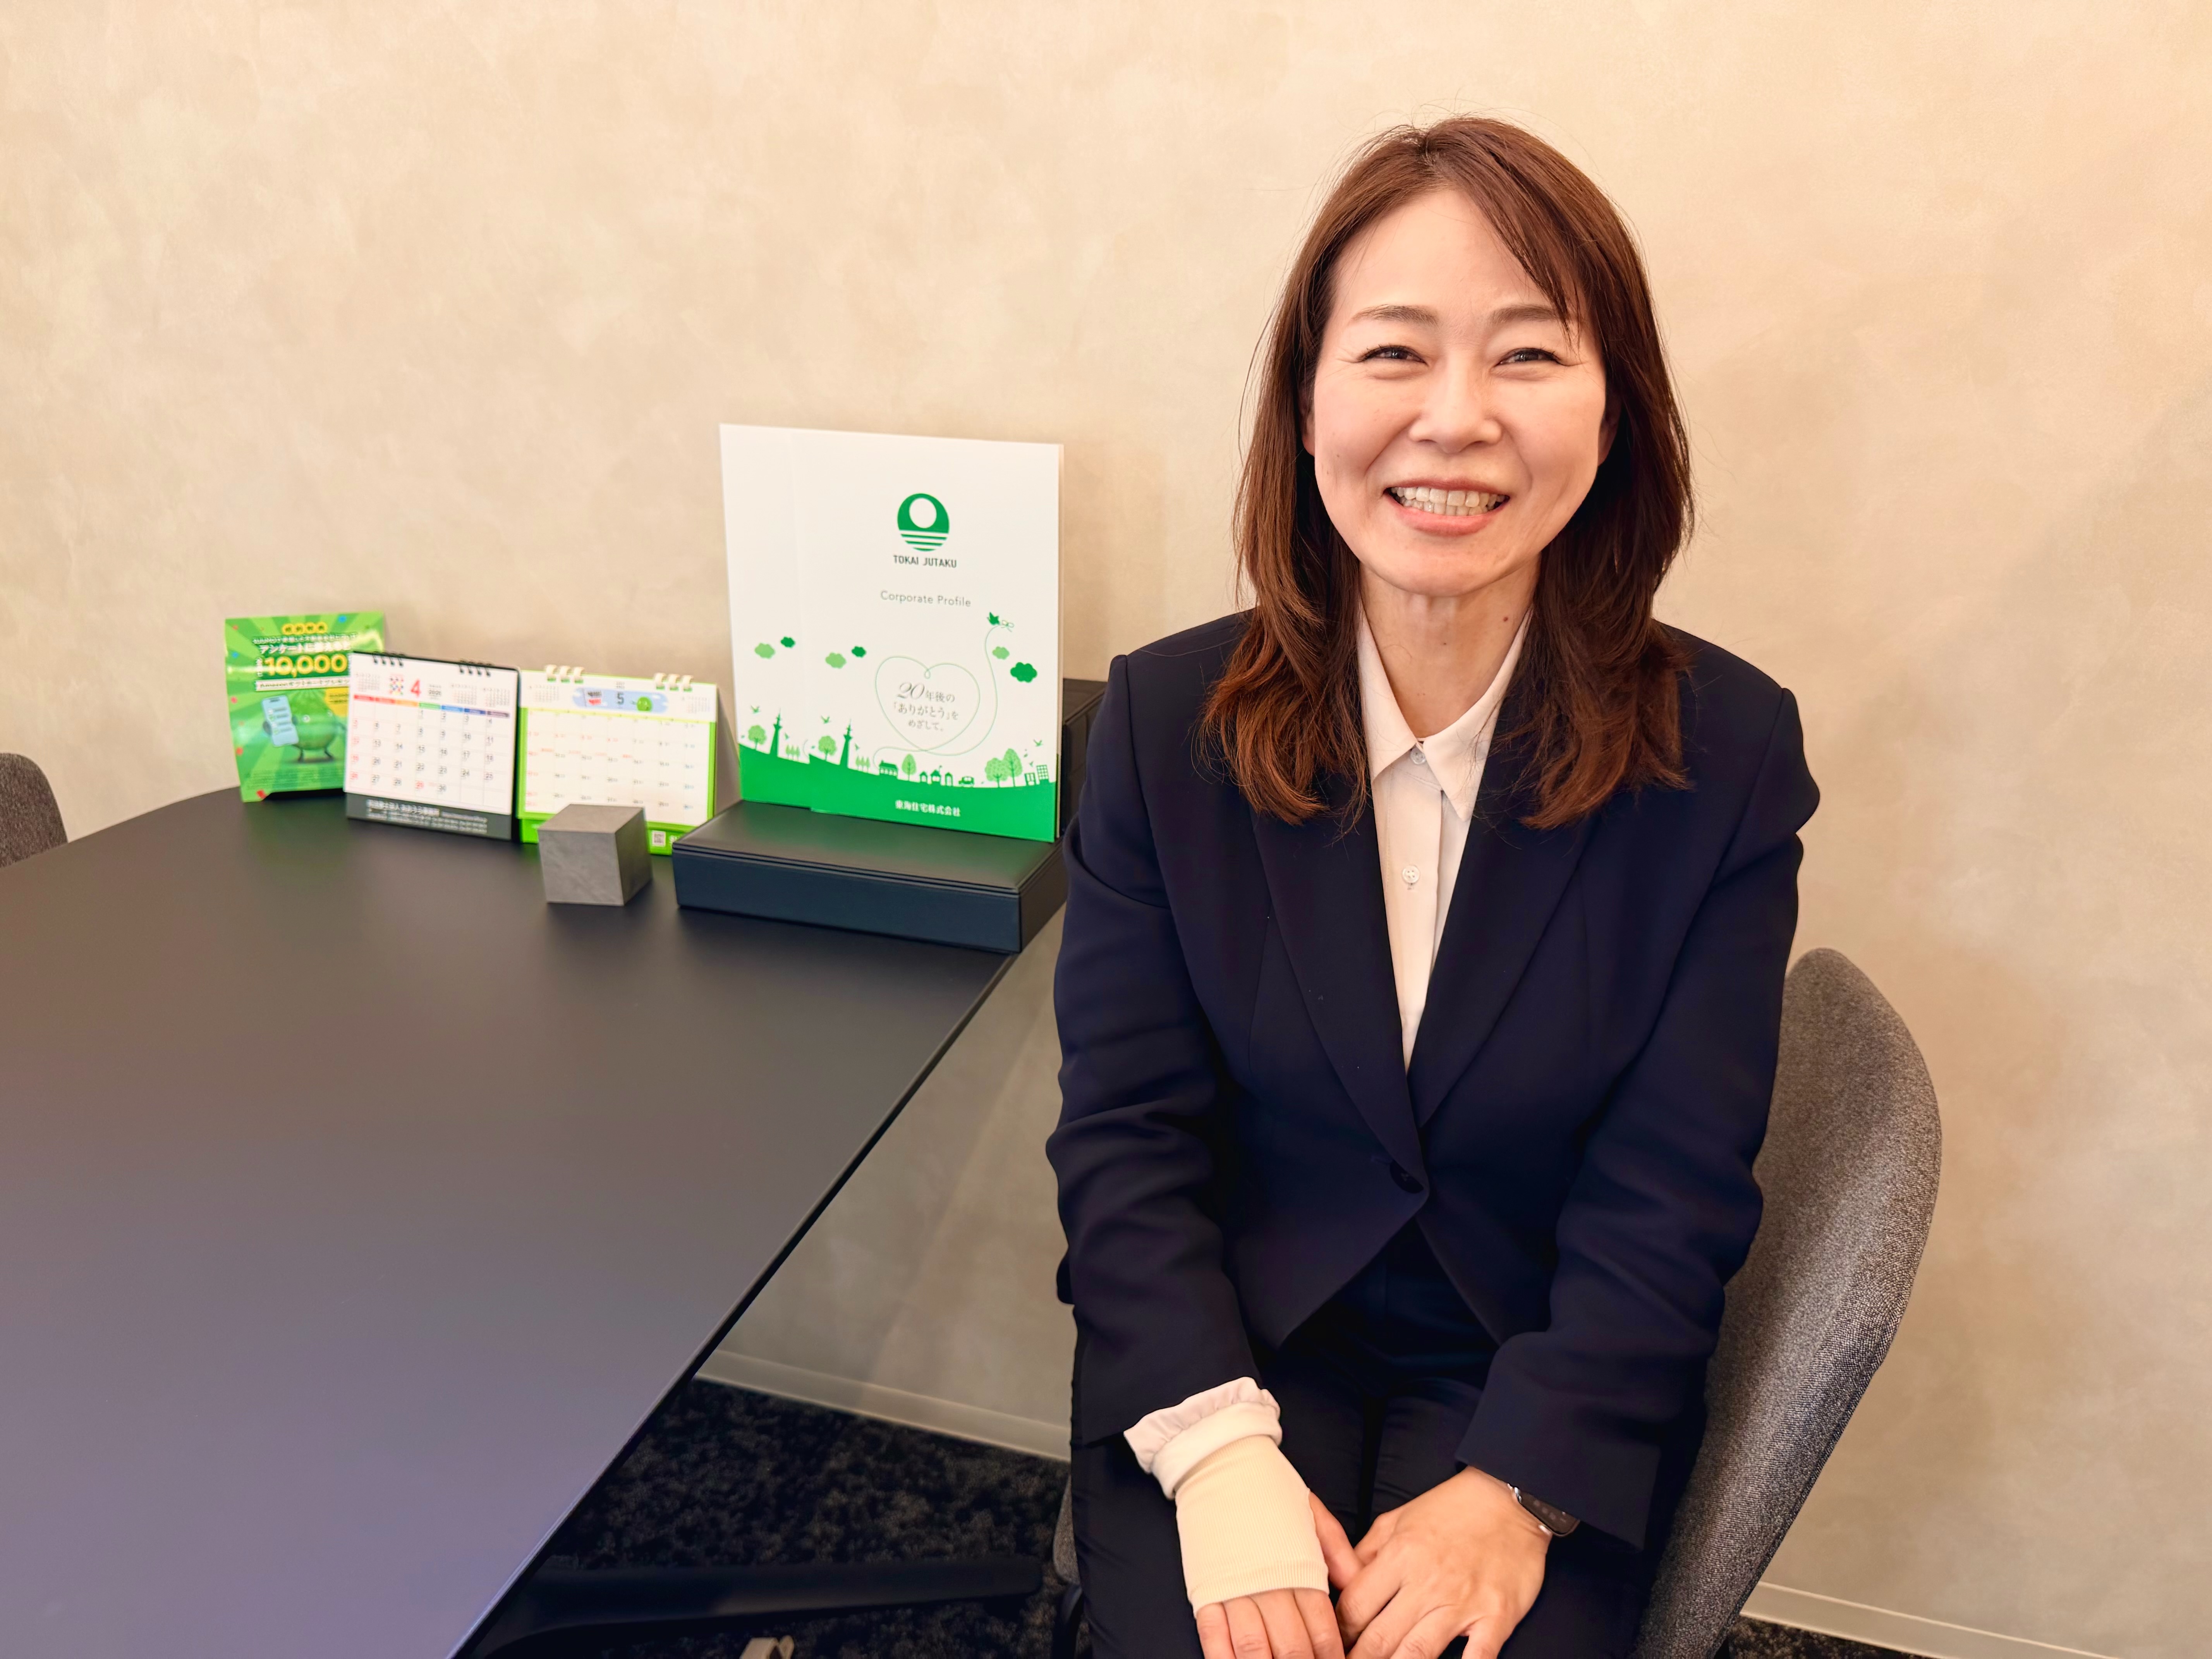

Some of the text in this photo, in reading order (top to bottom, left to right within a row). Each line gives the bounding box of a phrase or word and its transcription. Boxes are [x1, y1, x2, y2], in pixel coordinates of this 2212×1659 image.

[893, 555, 957, 568] TOKAI JUTAKU
[881, 590, 971, 607] Corporate Profile
[410, 678, 421, 697] 4
[897, 682, 955, 703] 20年後の
[617, 692, 624, 705] 5
[894, 702, 958, 720] 「ありがとう」を
[908, 720, 943, 731] めざして。
[895, 799, 961, 817] 東海住宅株式会社
